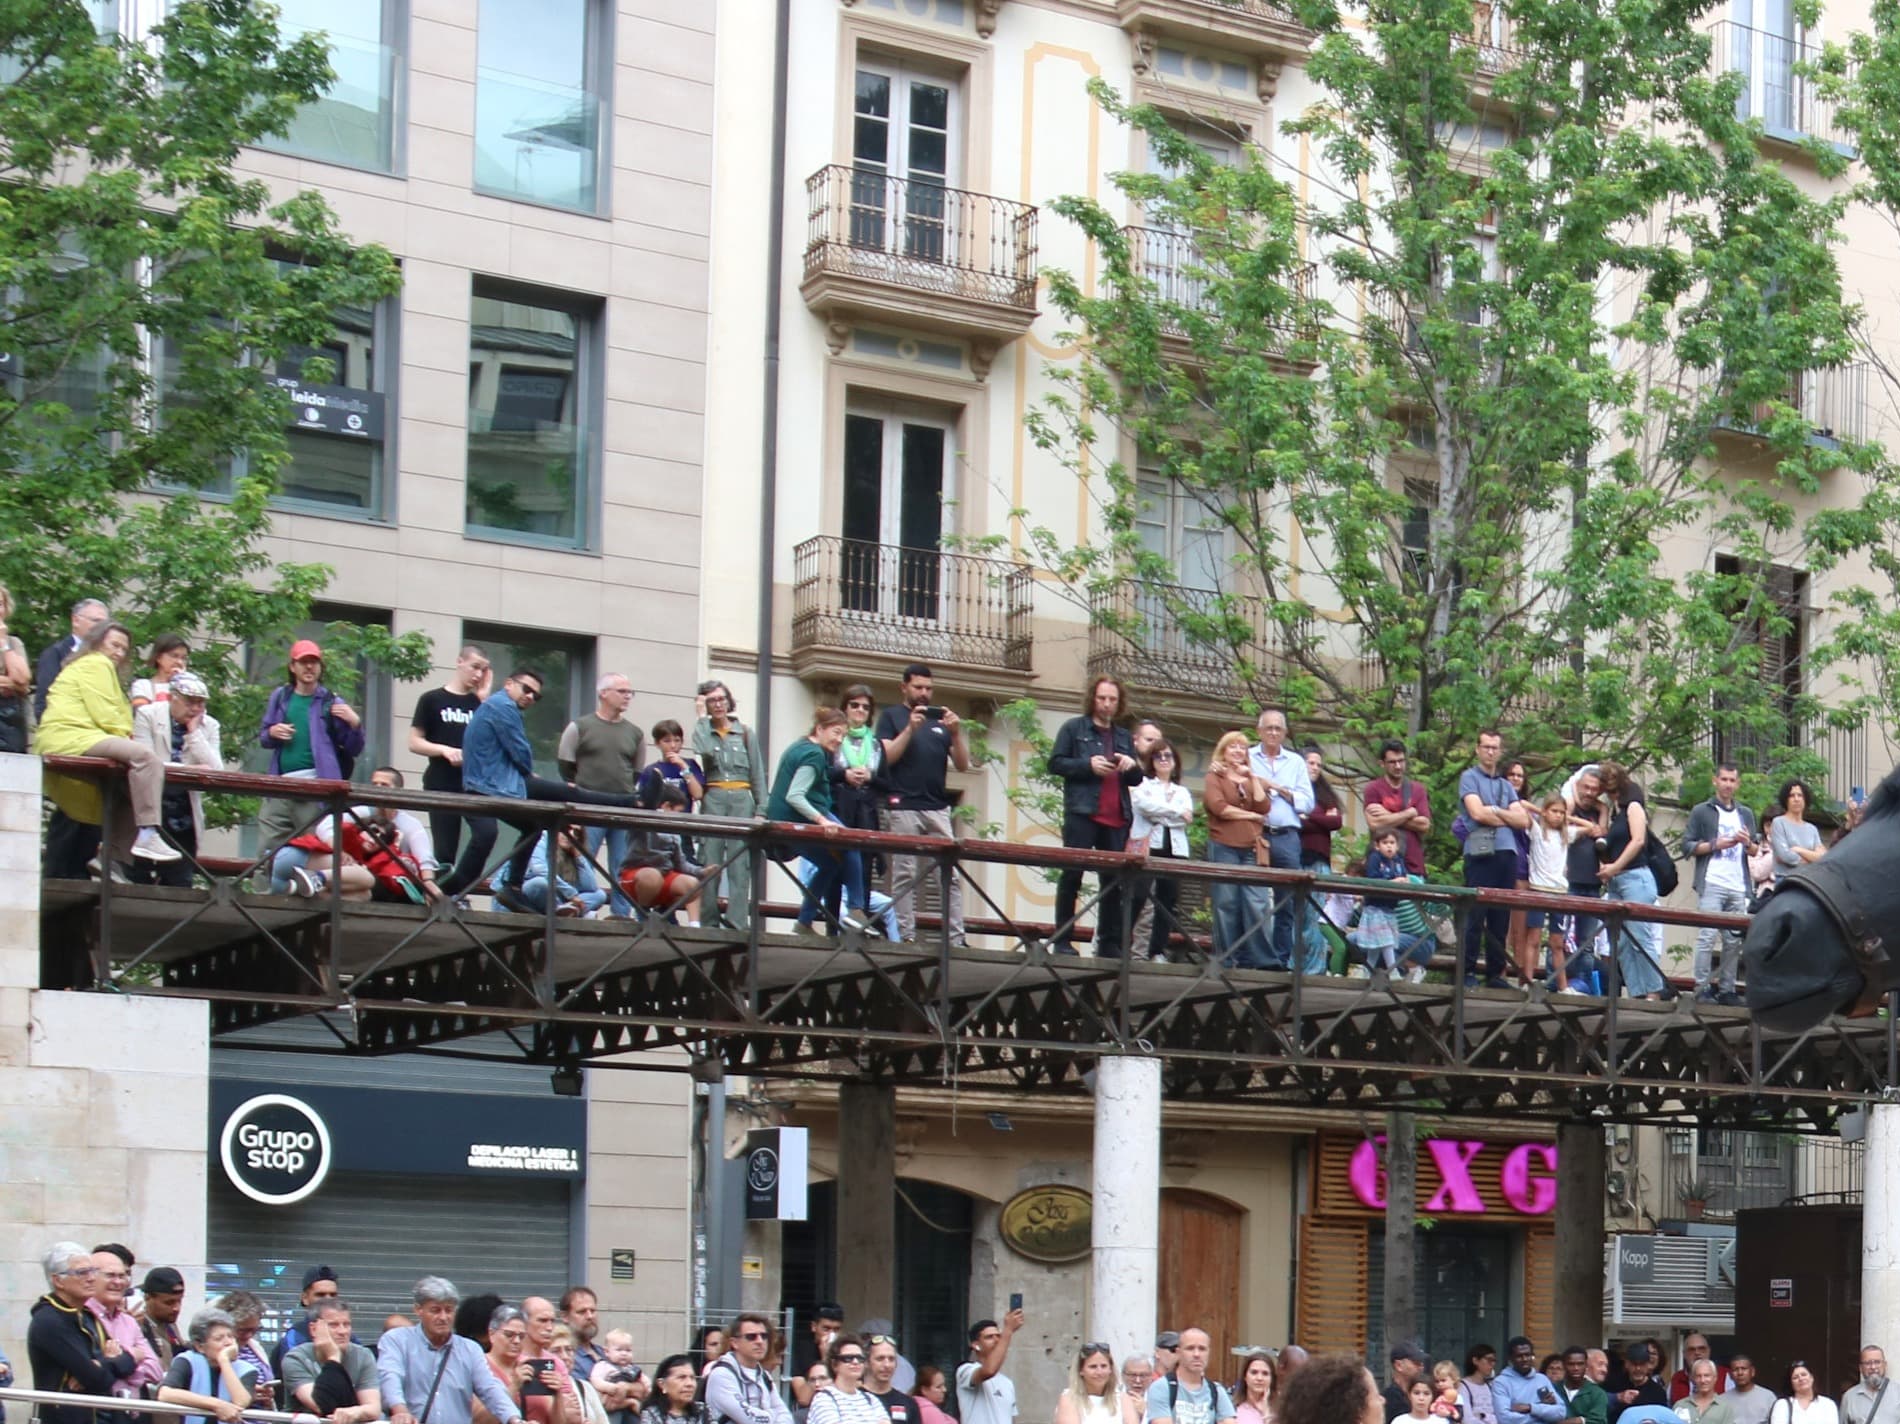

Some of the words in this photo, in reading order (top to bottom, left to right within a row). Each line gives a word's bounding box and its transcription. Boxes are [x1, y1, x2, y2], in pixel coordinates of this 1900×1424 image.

[239, 1124, 314, 1153] Grupo
[247, 1147, 304, 1174] stop
[467, 1155, 524, 1169] MEDICINA
[1621, 1248, 1649, 1267] Kapp
